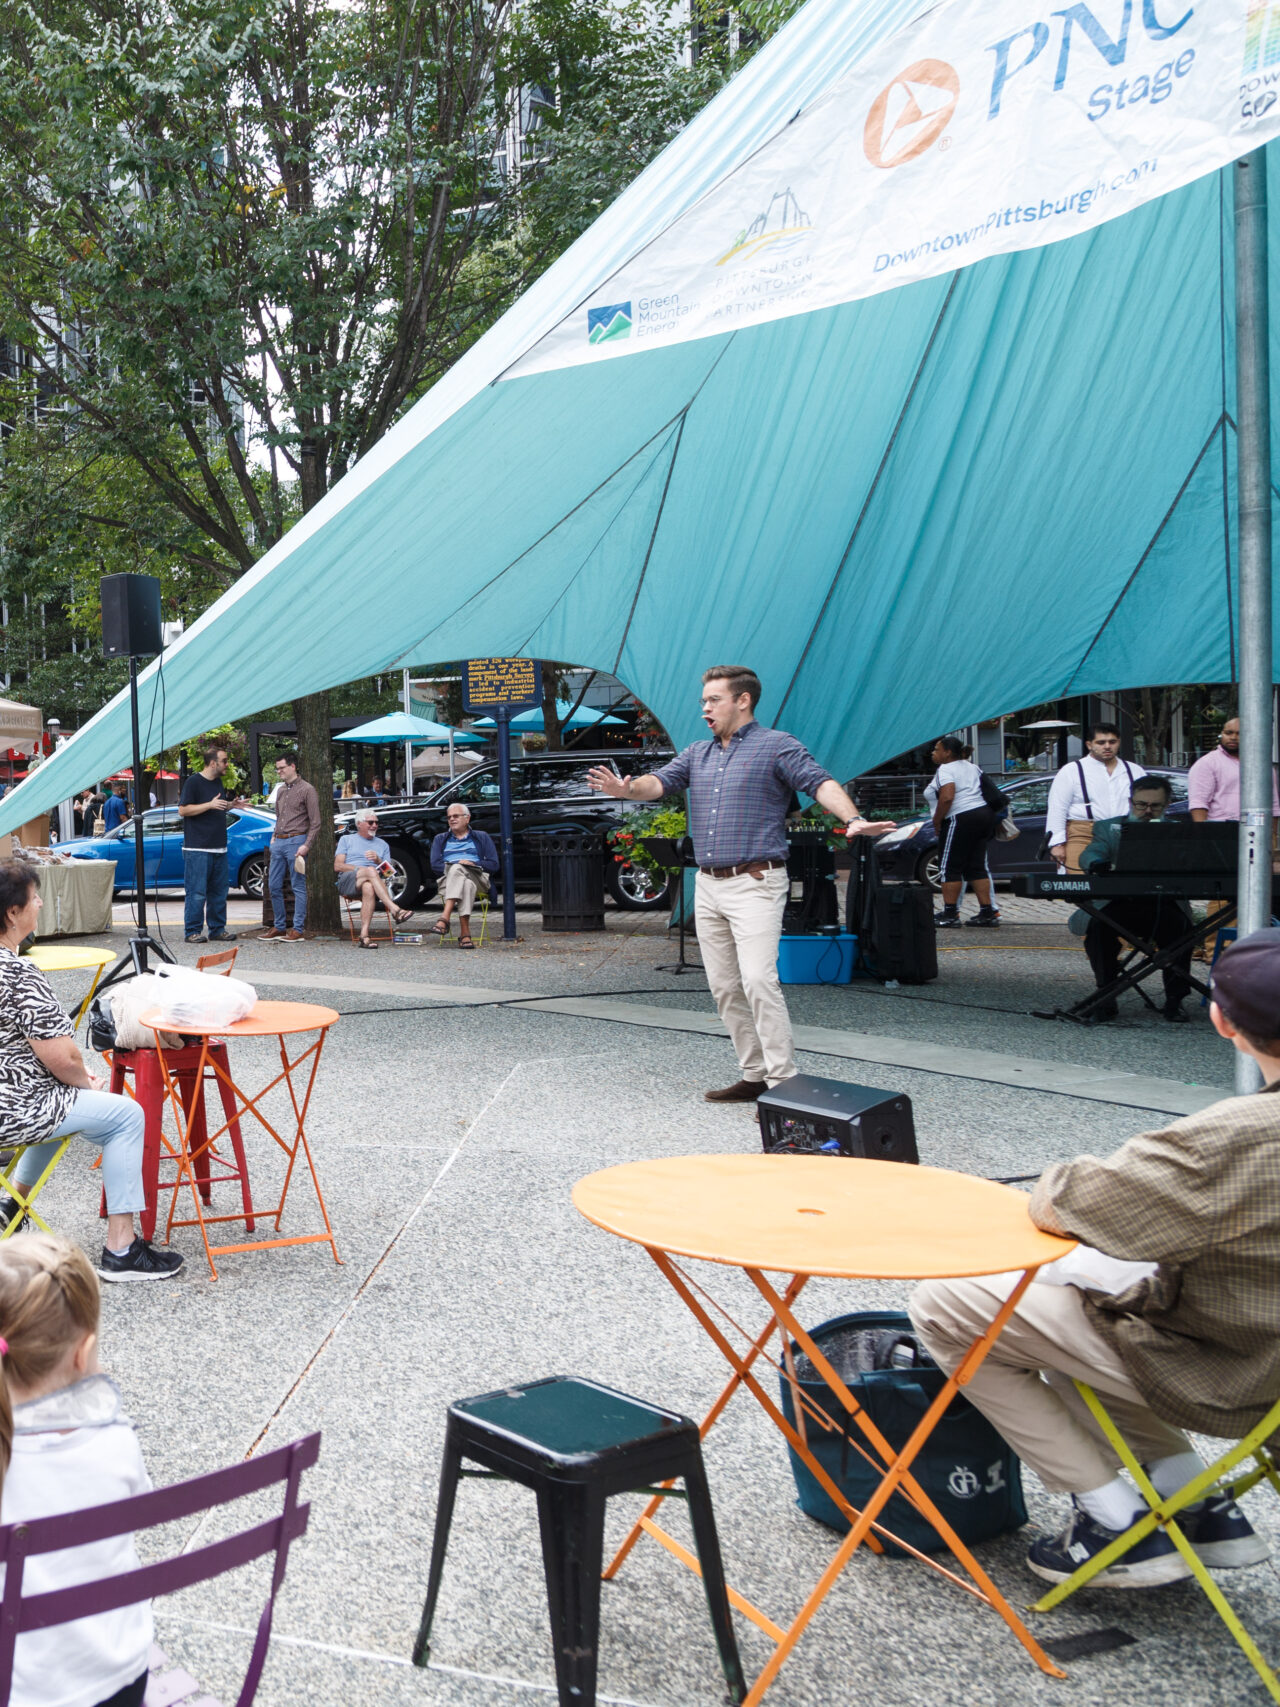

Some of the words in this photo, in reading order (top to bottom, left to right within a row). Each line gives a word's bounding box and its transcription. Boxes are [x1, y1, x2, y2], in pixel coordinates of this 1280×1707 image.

[984, 0, 1195, 122] PNC
[1086, 48, 1196, 122] Stage
[871, 157, 1160, 274] DowntownPittsburgh.com
[638, 293, 680, 311] Green
[638, 301, 702, 324] Mountain
[1052, 881, 1091, 891] YAMAHA
